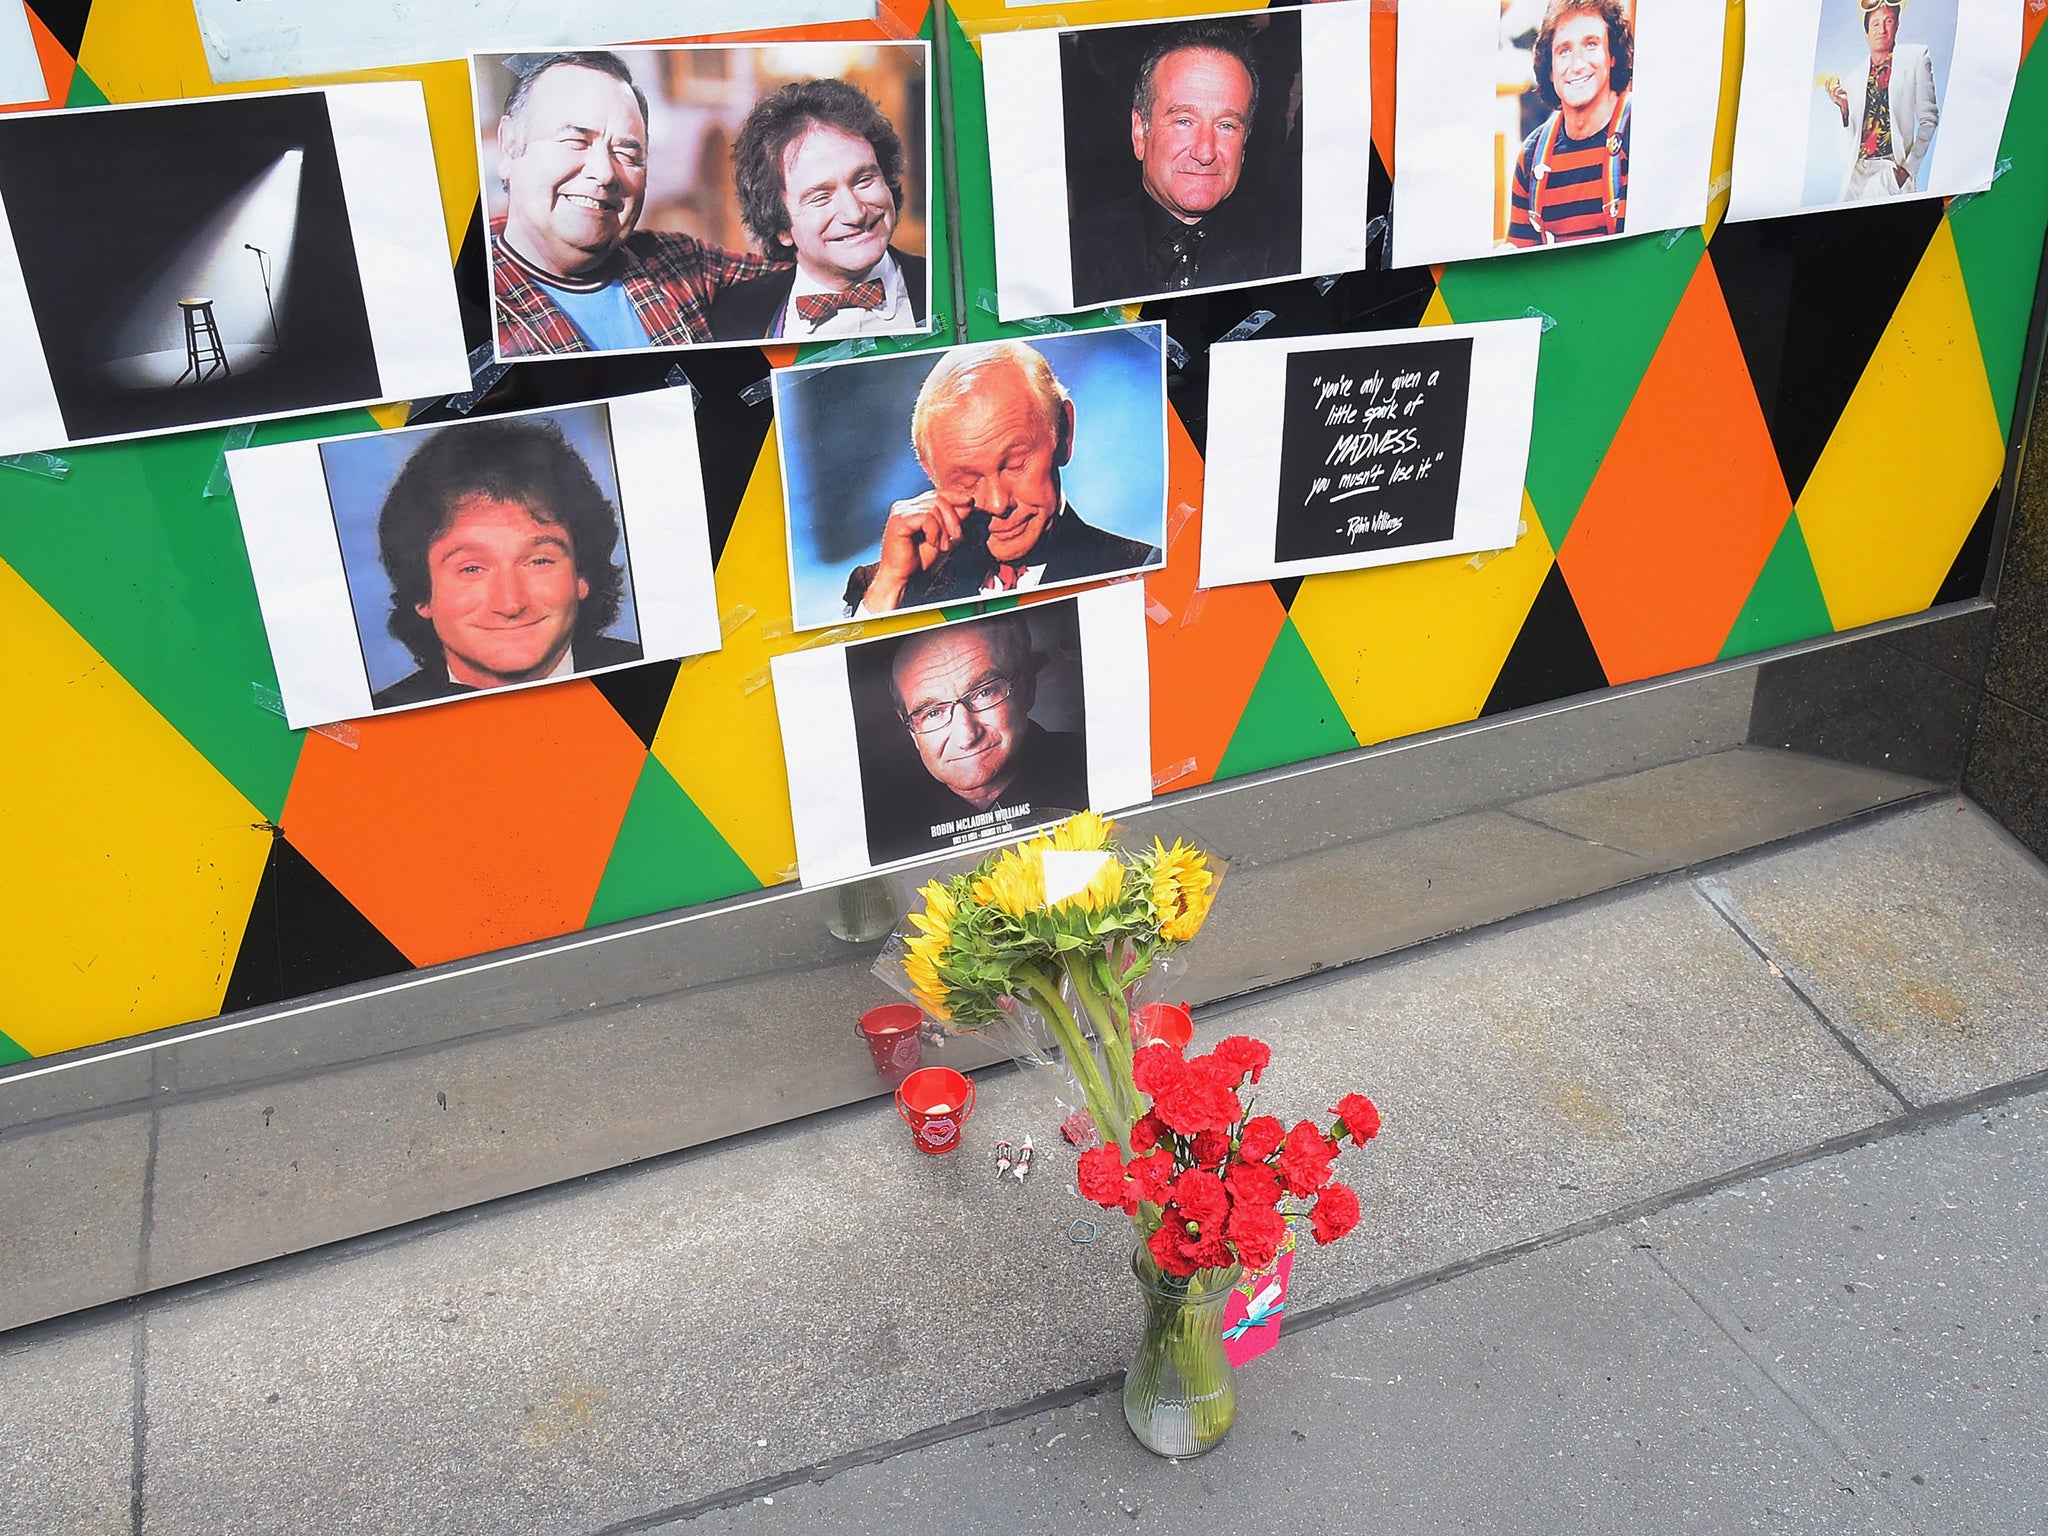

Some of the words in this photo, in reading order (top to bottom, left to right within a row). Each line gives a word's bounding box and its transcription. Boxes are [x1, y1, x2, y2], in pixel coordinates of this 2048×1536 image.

[1360, 369, 1385, 405] only
[1382, 369, 1421, 403] given
[1427, 370, 1440, 387] a
[1324, 403, 1358, 427] little
[1362, 400, 1397, 433] spark
[1403, 393, 1424, 417] of
[1324, 427, 1421, 466] MADNESS.
[1304, 477, 1331, 507] you
[1338, 464, 1385, 490] musn't
[1388, 459, 1414, 485] lose
[1347, 516, 1370, 545] Robin
[1371, 510, 1404, 535] Williams
[930, 822, 955, 838] ROBIN
[956, 812, 993, 831] MCLAURIN
[995, 803, 1030, 822] WILLIAMS
